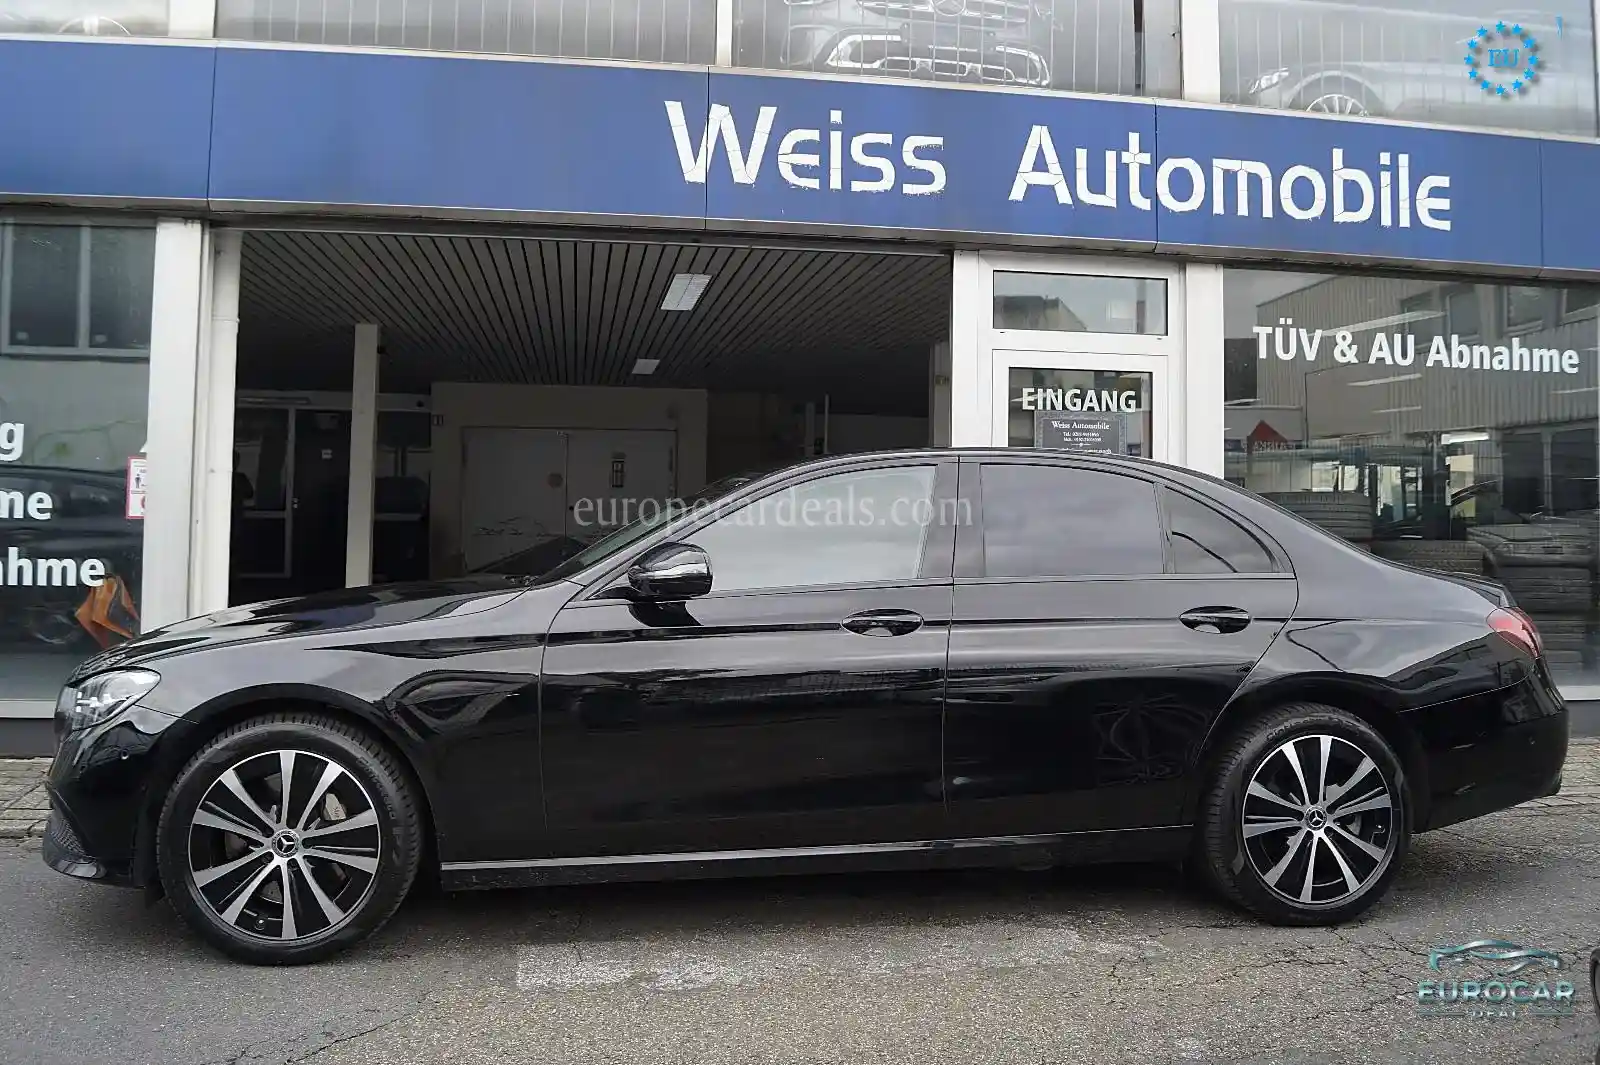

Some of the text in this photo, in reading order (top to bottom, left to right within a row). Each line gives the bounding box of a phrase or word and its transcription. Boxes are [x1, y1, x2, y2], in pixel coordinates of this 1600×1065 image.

[664, 100, 1453, 232] Weiss Automobile
[1253, 317, 1580, 374] TÜV & AU Abnahme
[1021, 387, 1137, 413] EINGANG
[0, 546, 106, 587] hme
